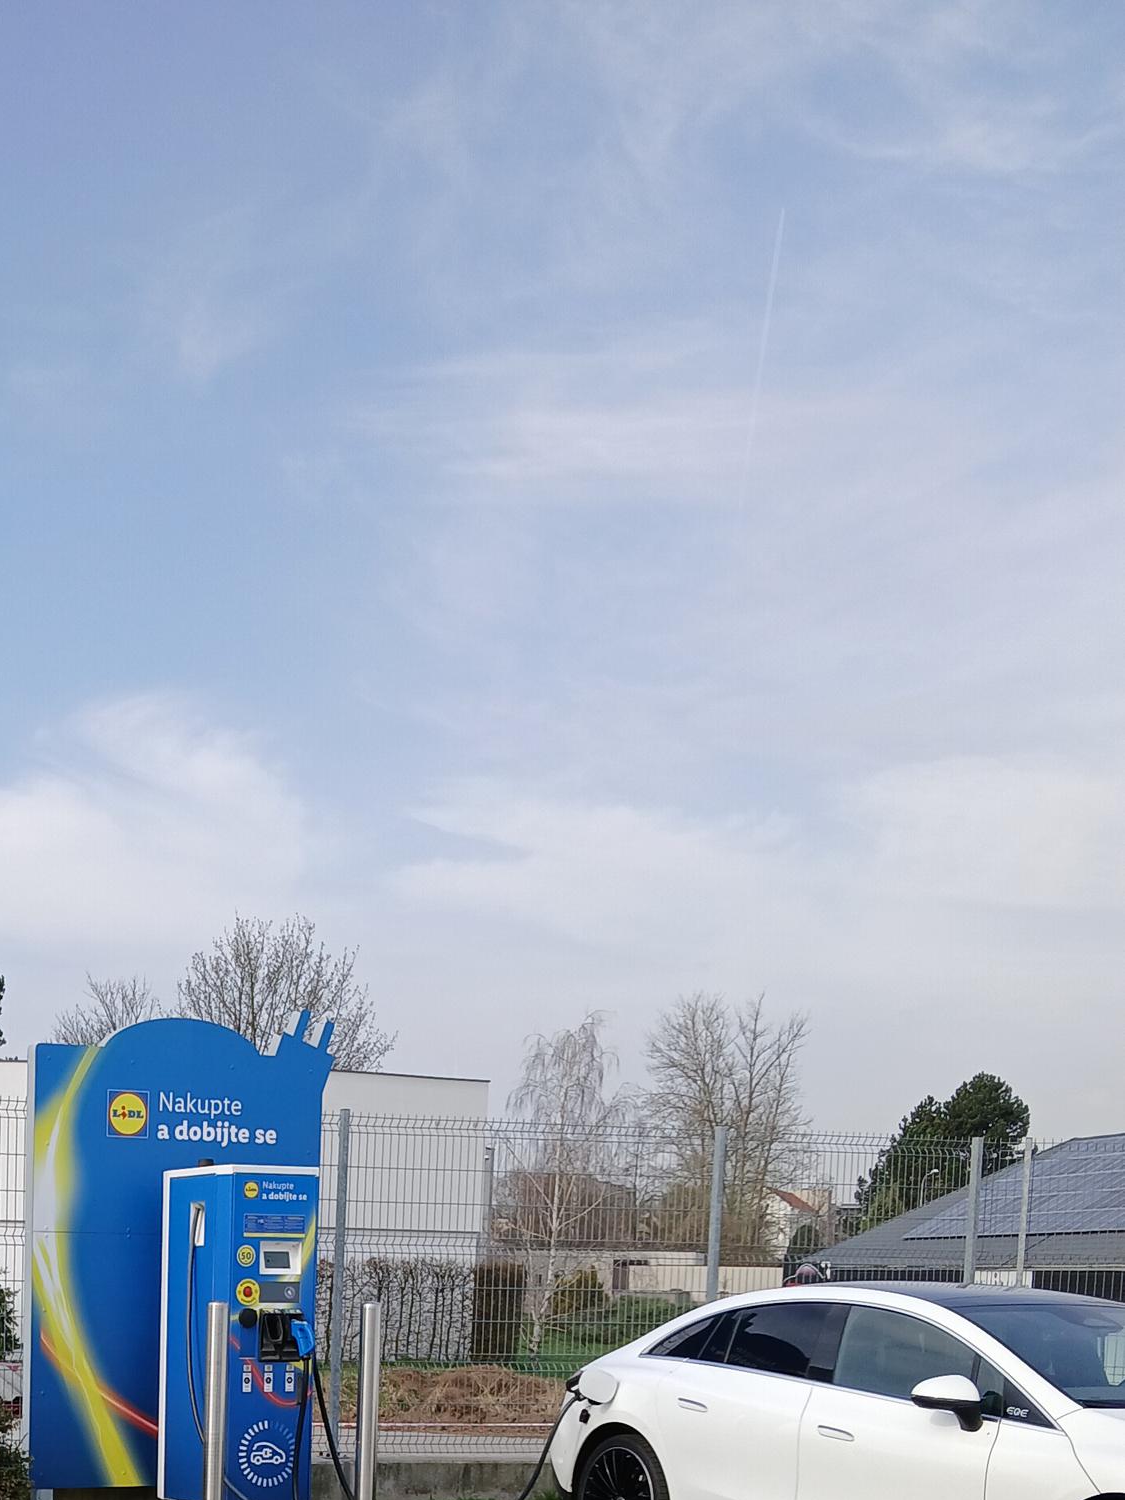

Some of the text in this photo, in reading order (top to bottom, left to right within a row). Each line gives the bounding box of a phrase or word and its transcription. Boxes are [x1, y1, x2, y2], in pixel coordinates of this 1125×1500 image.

[159, 1091, 242, 1119] Nakupte
[157, 1120, 277, 1147] a dobijte se
[262, 1181, 294, 1191] Nakupte
[268, 1191, 297, 1202] dobijte
[241, 1252, 251, 1260] 50
[1006, 1406, 1029, 1418] EQE
